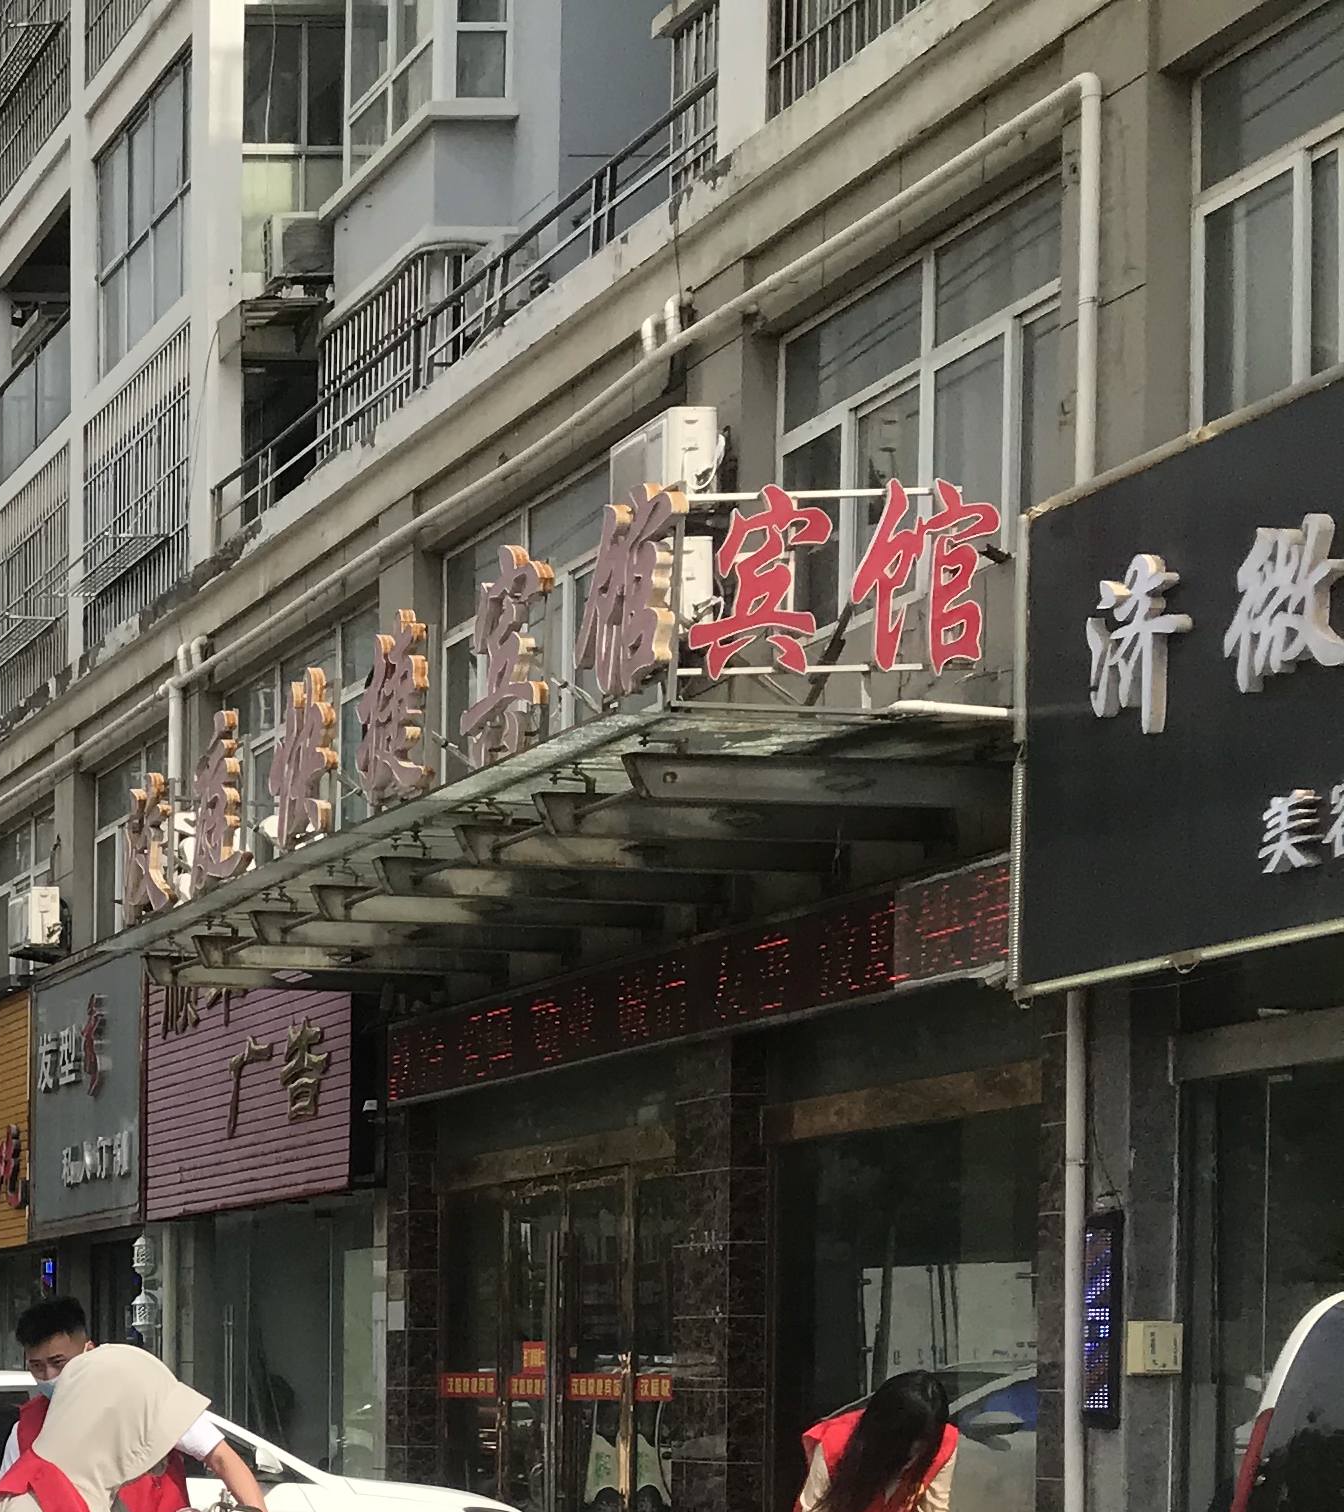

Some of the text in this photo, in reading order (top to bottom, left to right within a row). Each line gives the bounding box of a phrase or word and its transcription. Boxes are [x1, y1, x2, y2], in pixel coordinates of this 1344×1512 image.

[689, 478, 1001, 681] 宾馆
[1257, 780, 1344, 874] 美
[37, 1023, 80, 1093] 发型
[227, 1015, 330, 1138] 广告
